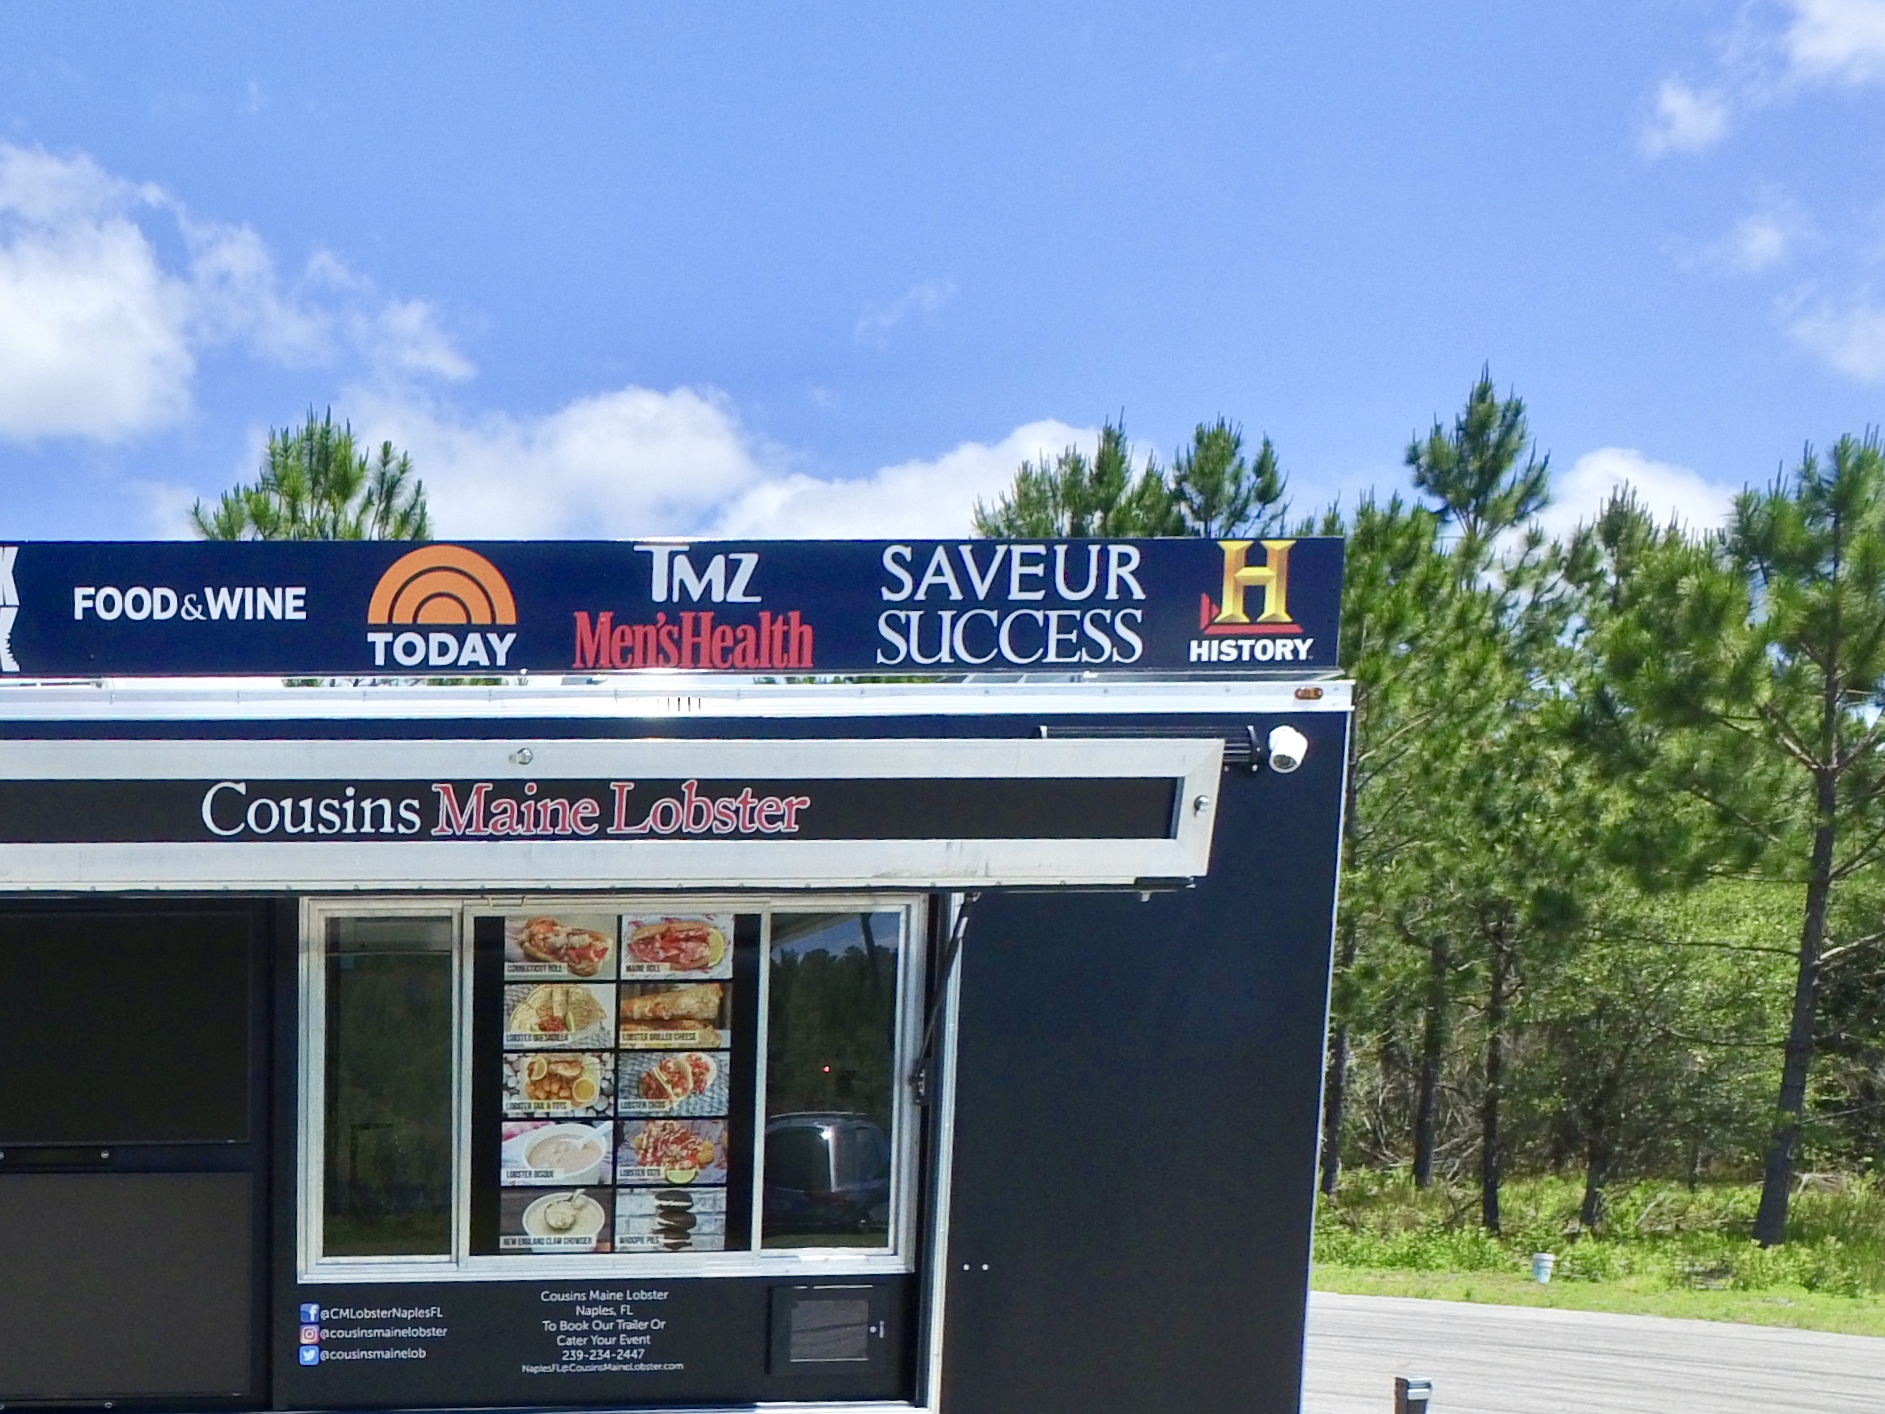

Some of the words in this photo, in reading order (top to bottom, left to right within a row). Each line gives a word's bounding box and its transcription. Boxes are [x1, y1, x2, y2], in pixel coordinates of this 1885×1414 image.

[633, 545, 763, 604] TMZ
[879, 543, 1147, 602] SAVEUR
[875, 609, 1144, 666] SUCCESS
[366, 632, 517, 667] TODAY
[1188, 638, 1315, 662] HISTORY
[201, 780, 422, 837] Cousins
[430, 782, 601, 837] Maine
[605, 779, 812, 835] Lobster
[540, 1290, 587, 1302] Cousins
[589, 1289, 624, 1301] Maine
[626, 1289, 669, 1301] Lobster
[319, 1306, 444, 1321] @CMLobsterNaplesFL
[575, 1304, 617, 1318] Naples,
[620, 1304, 634, 1316] FL
[542, 1320, 557, 1332] To
[559, 1320, 589, 1332] Book
[591, 1320, 615, 1331] Our
[616, 1319, 649, 1331] Trailer
[650, 1318, 666, 1330] Or
[319, 1326, 448, 1339] @cousinsmainelobster
[556, 1335, 587, 1347] Cater
[590, 1334, 617, 1346] Your
[619, 1333, 652, 1345] Event
[319, 1347, 427, 1361] @cousinsmainelob
[562, 1348, 646, 1361] 239-234-2447
